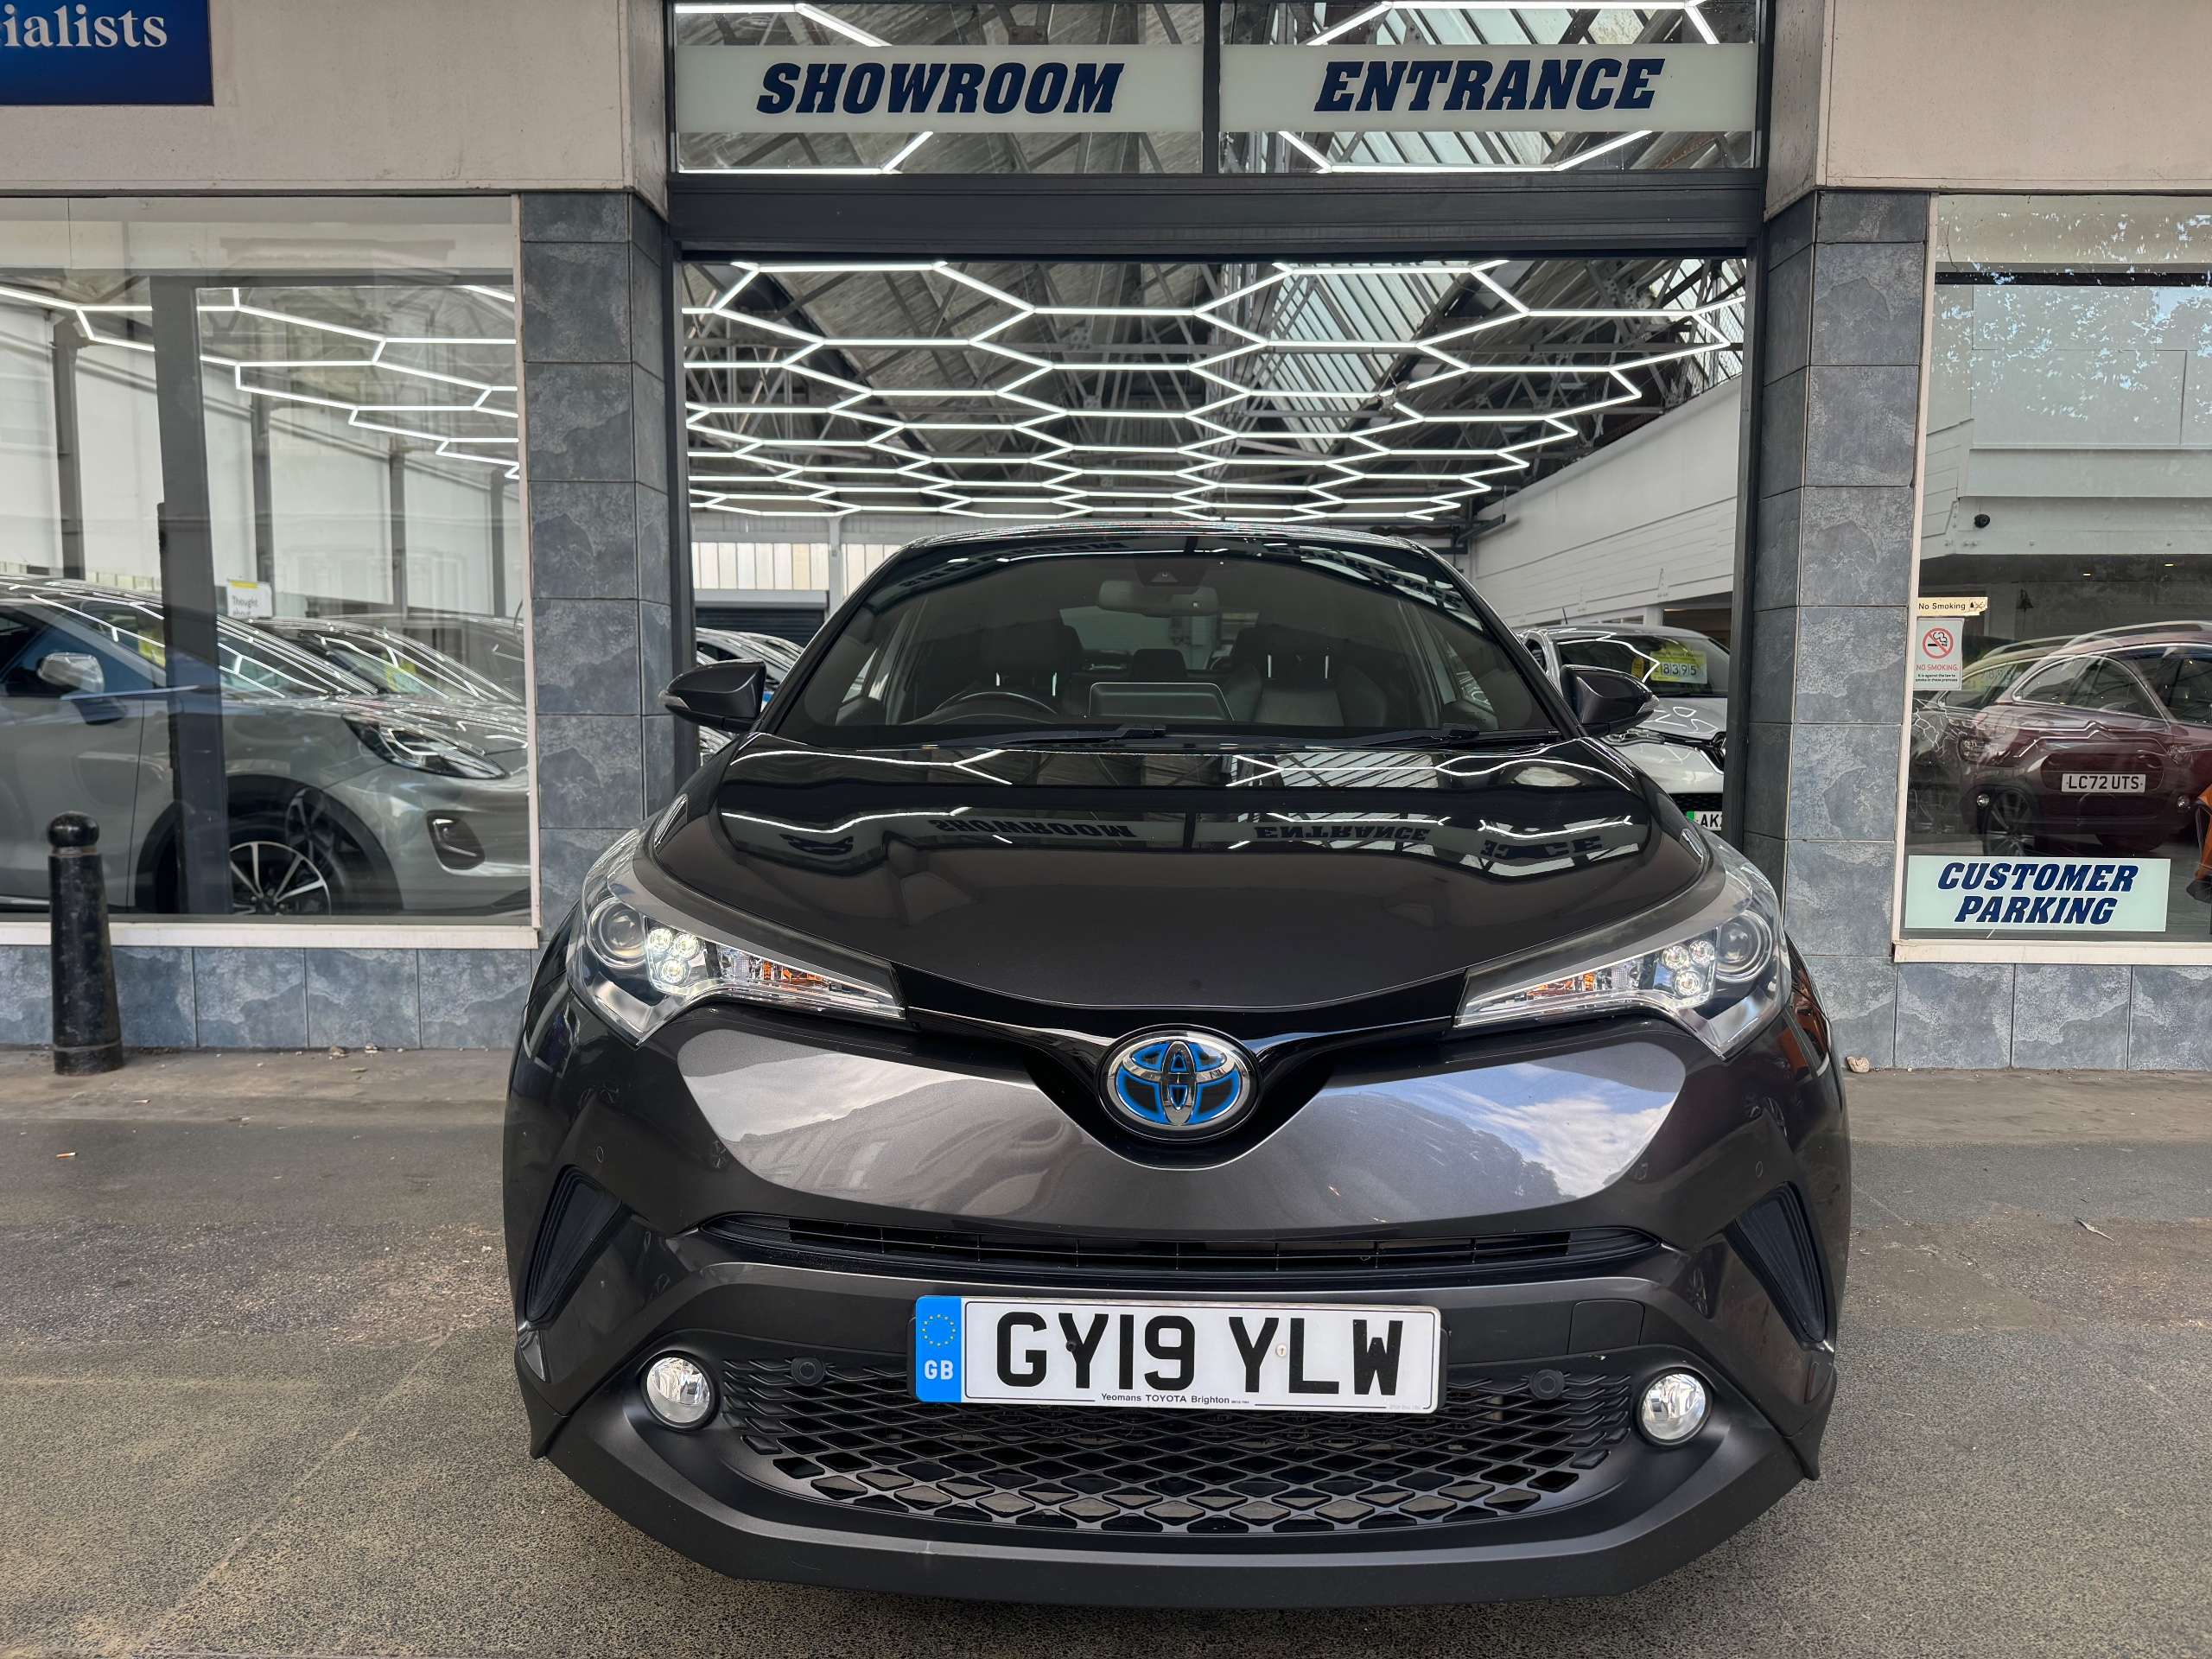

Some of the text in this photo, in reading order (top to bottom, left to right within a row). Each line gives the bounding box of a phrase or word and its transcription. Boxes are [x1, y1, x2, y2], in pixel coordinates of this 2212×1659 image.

[0, 3, 168, 48] ialists
[755, 58, 1666, 115] SHOWROOM ENTRANCE
[1932, 602, 1966, 611] Smoking
[1663, 663, 1697, 676] 8395
[2069, 775, 2139, 790] LC72 UTS
[1700, 814, 1722, 827] AK
[1937, 862, 2139, 892] CUSTOMER
[1955, 896, 2118, 925] PARKING
[996, 1312, 1403, 1396] GY19 YLW
[924, 1359, 954, 1380] GB
[1101, 1393, 1141, 1402] Yeomans
[1145, 1395, 1187, 1403] TOYOTA
[1191, 1395, 1230, 1405] Brighton
